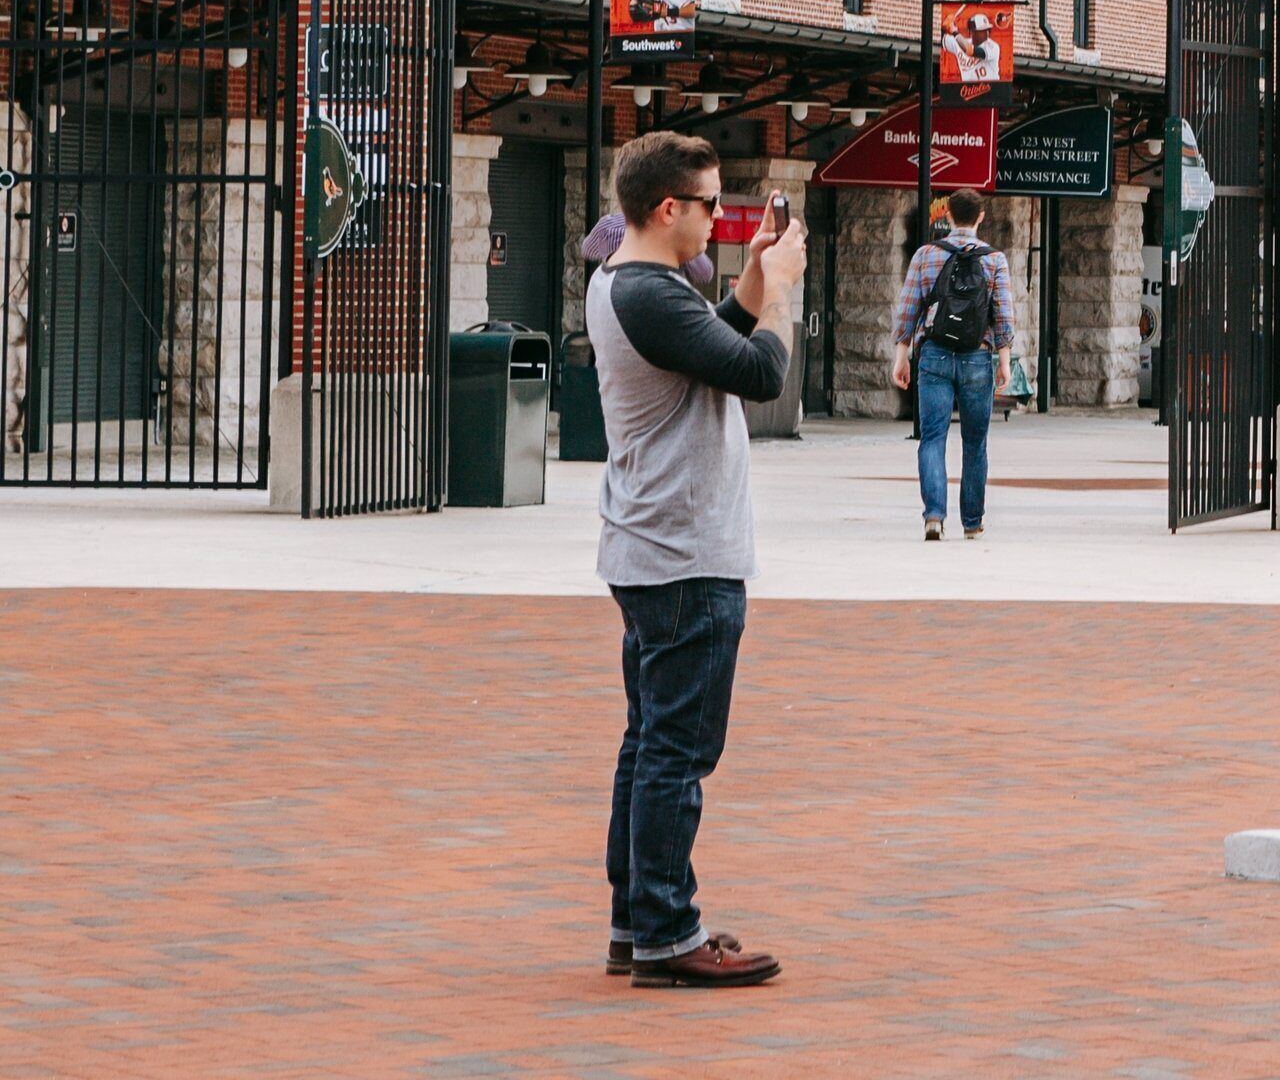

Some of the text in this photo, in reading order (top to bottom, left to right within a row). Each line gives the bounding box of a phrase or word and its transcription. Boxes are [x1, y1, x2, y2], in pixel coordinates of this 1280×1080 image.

[622, 39, 676, 51] Southwest
[884, 130, 917, 144] Bank
[1020, 137, 1076, 149] 323 WEST
[996, 149, 1100, 163] CAMDEN STREET
[996, 170, 1091, 185] AN ASSISTANCE
